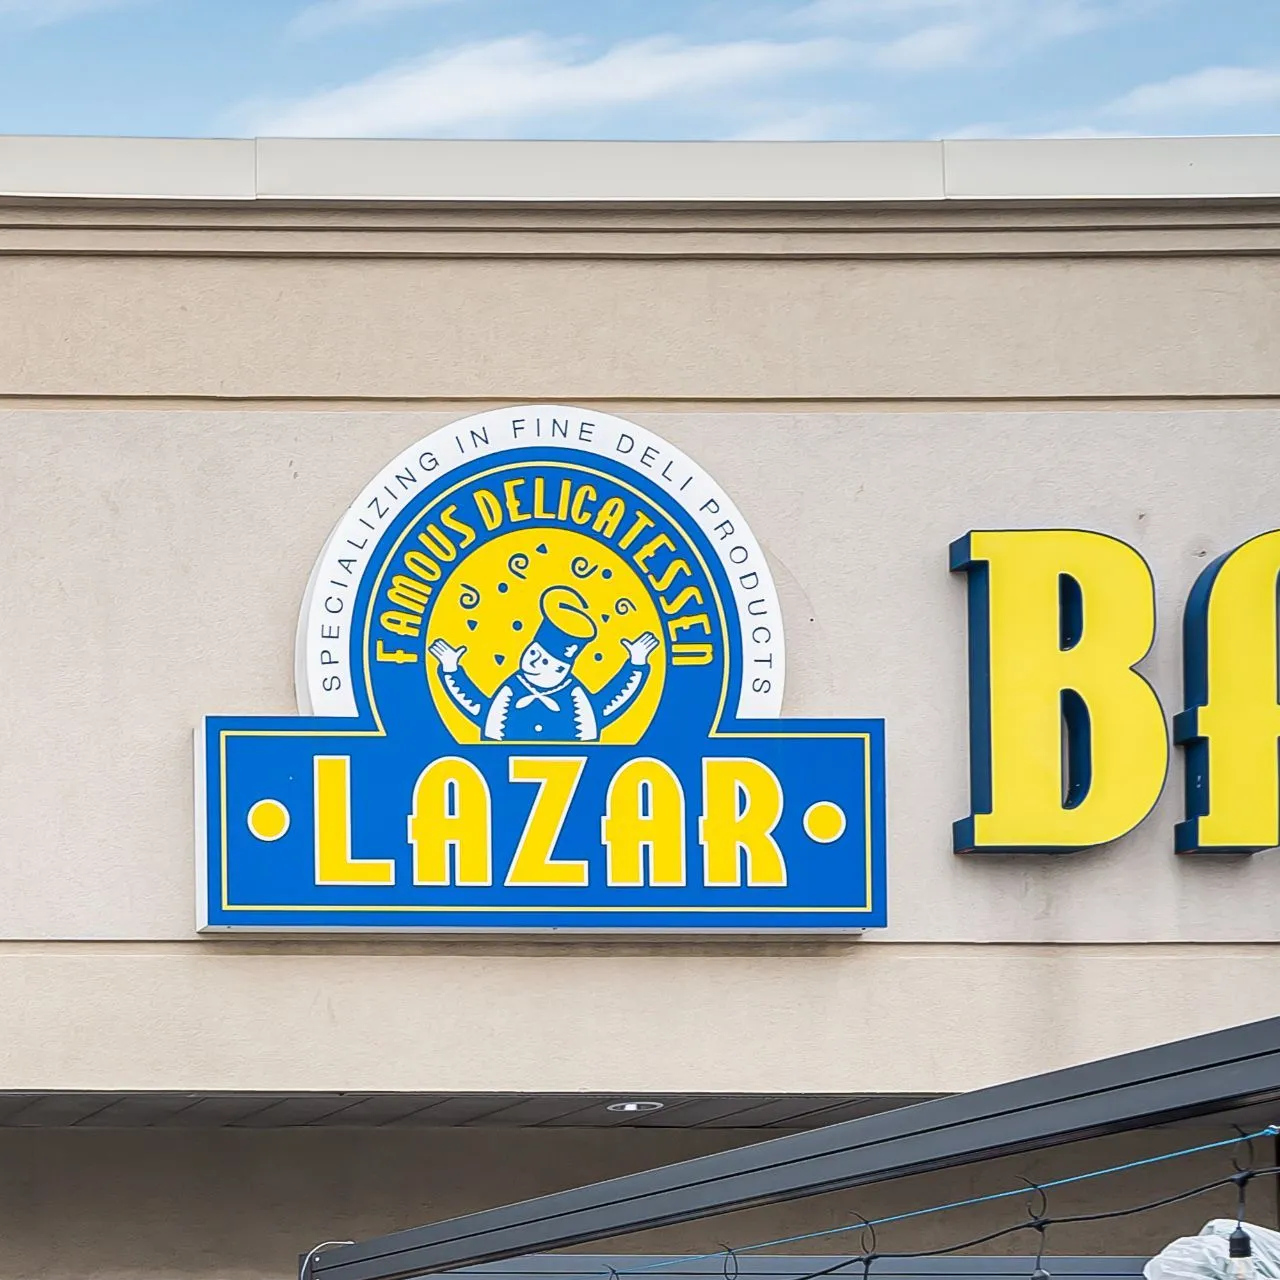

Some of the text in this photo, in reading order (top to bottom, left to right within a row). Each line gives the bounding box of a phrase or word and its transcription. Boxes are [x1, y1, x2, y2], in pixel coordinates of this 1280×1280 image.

[322, 417, 773, 695] SPECIALIZING IN FINE DELI PRODUCTS
[376, 475, 715, 668] FAMOUS DELICATESSEN
[311, 753, 788, 888] LAZAR
